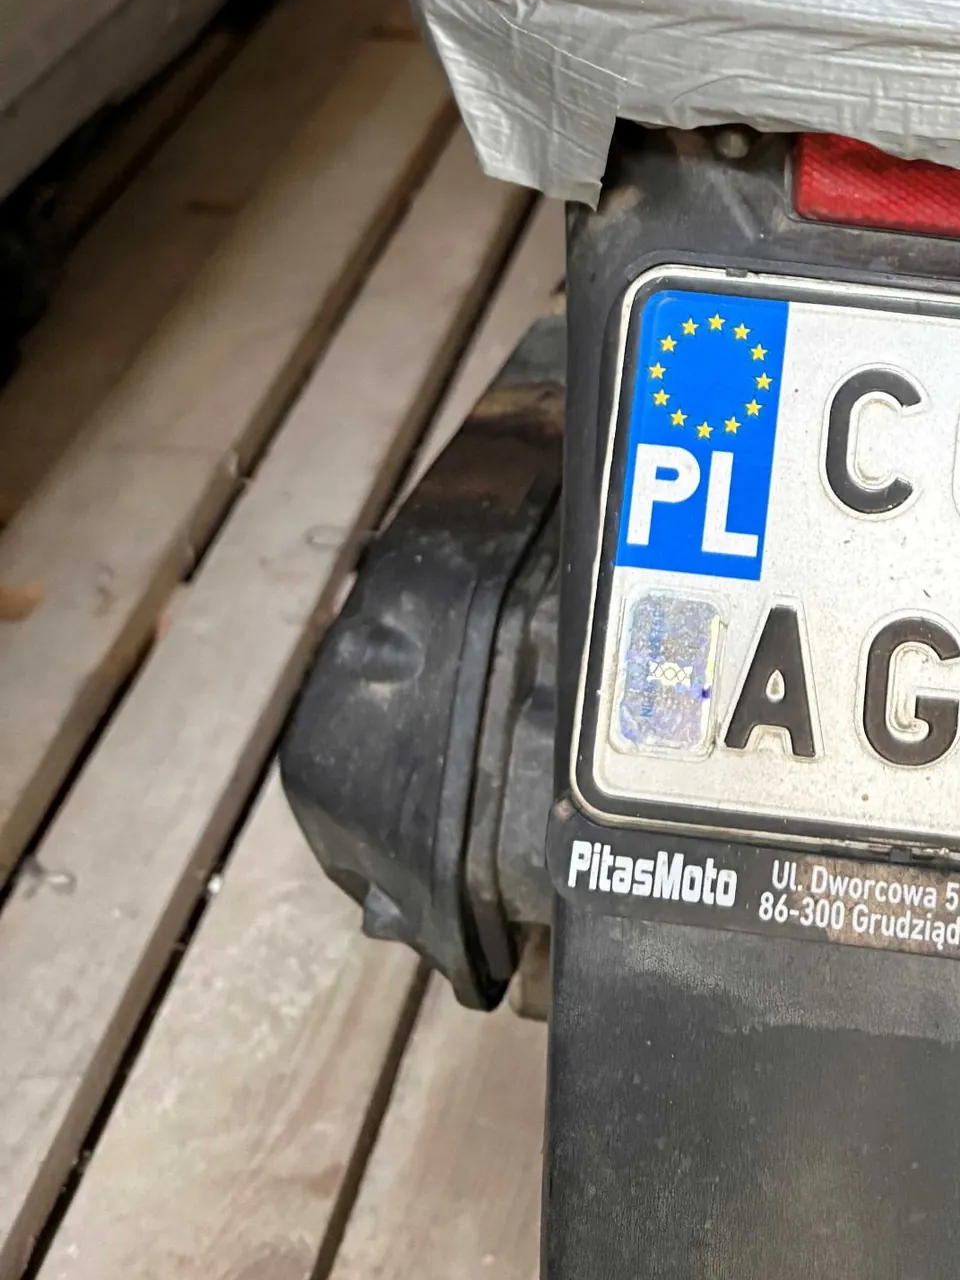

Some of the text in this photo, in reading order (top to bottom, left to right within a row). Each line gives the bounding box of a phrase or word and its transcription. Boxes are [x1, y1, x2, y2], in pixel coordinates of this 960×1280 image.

[626, 444, 759, 557] PL
[567, 840, 738, 907] PitasMoto
[771, 859, 801, 892] Ul.
[811, 866, 937, 910] Dworcowa
[758, 892, 845, 931] 86-300
